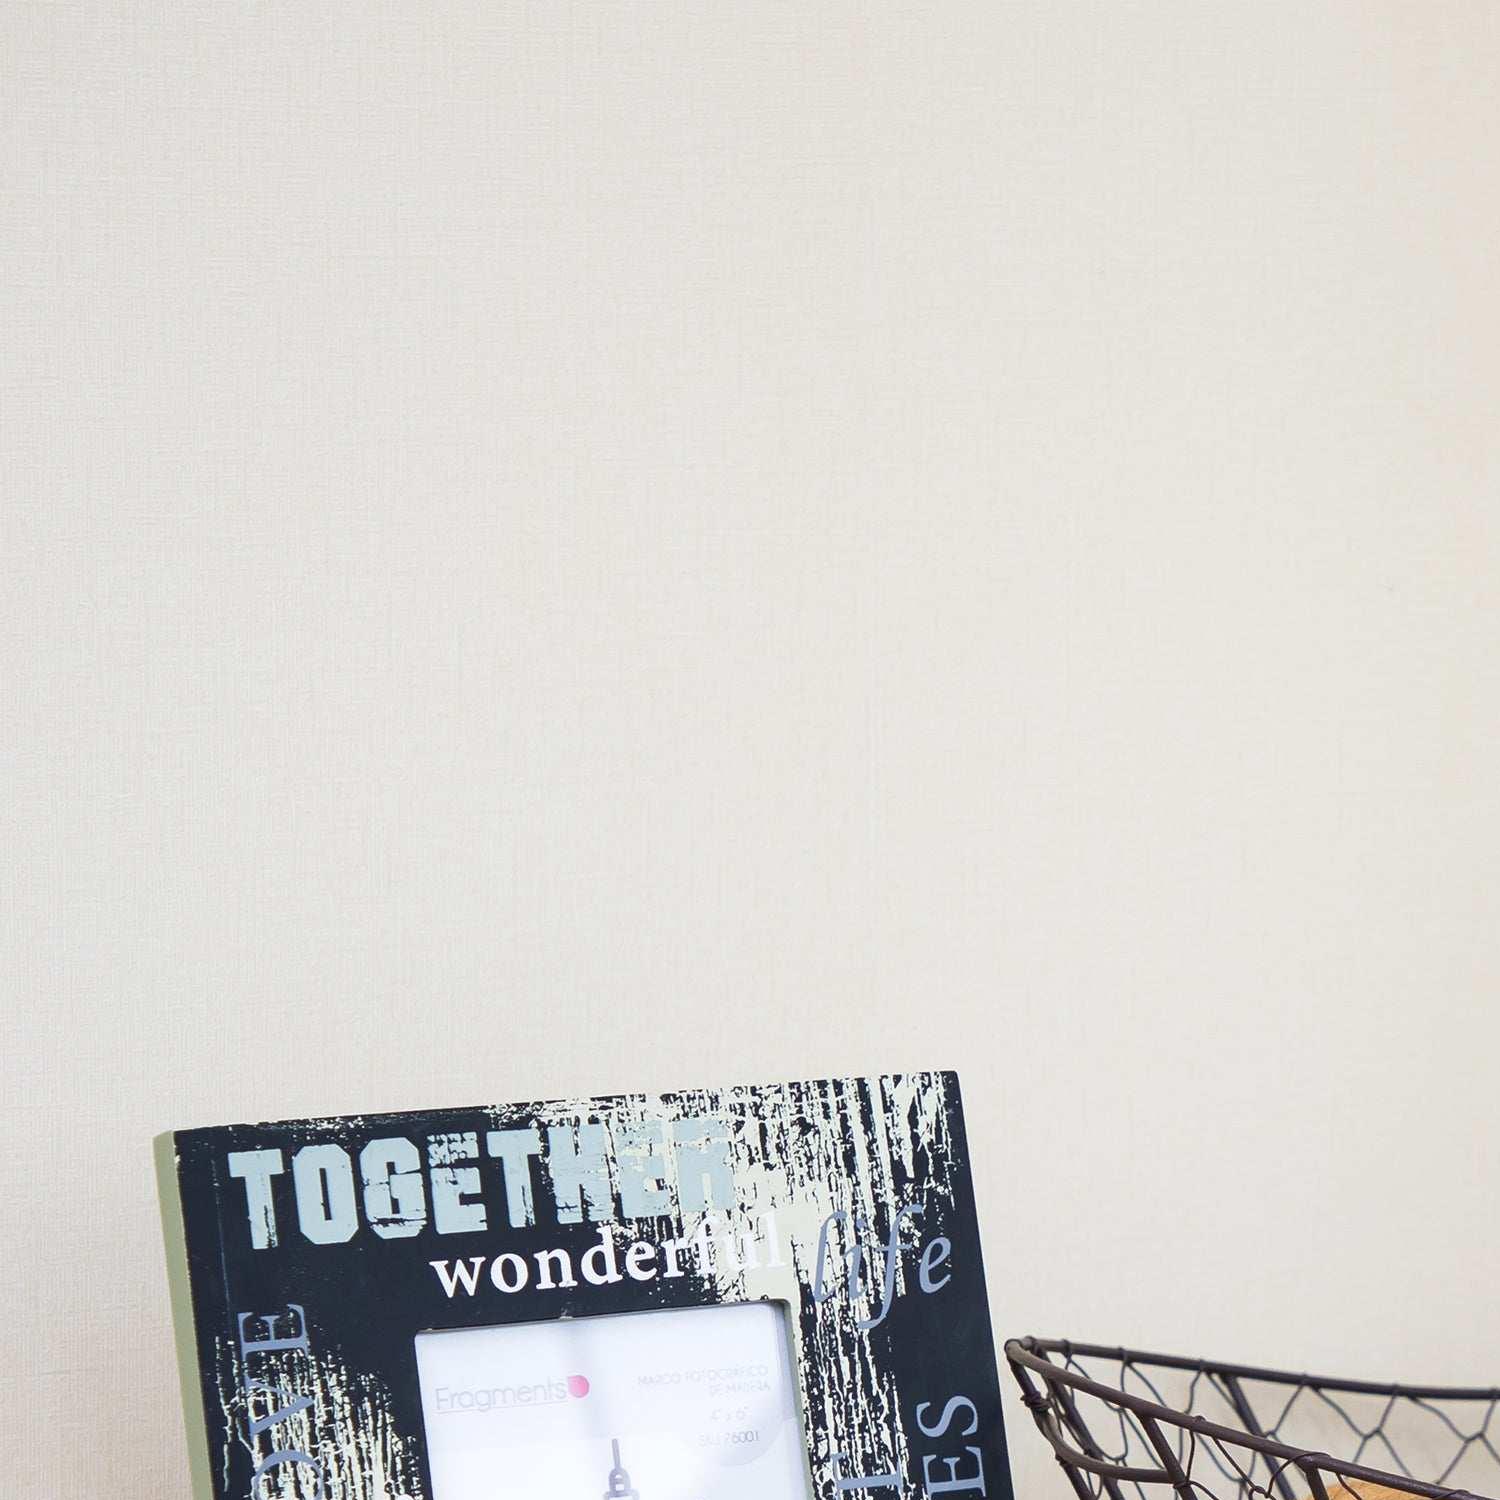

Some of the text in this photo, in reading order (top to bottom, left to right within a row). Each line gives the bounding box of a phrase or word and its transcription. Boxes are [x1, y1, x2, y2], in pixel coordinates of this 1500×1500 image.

[228, 1118, 737, 1250] TOGETHER
[429, 1204, 953, 1330] wonderful life
[434, 1375, 568, 1412] Fragments
